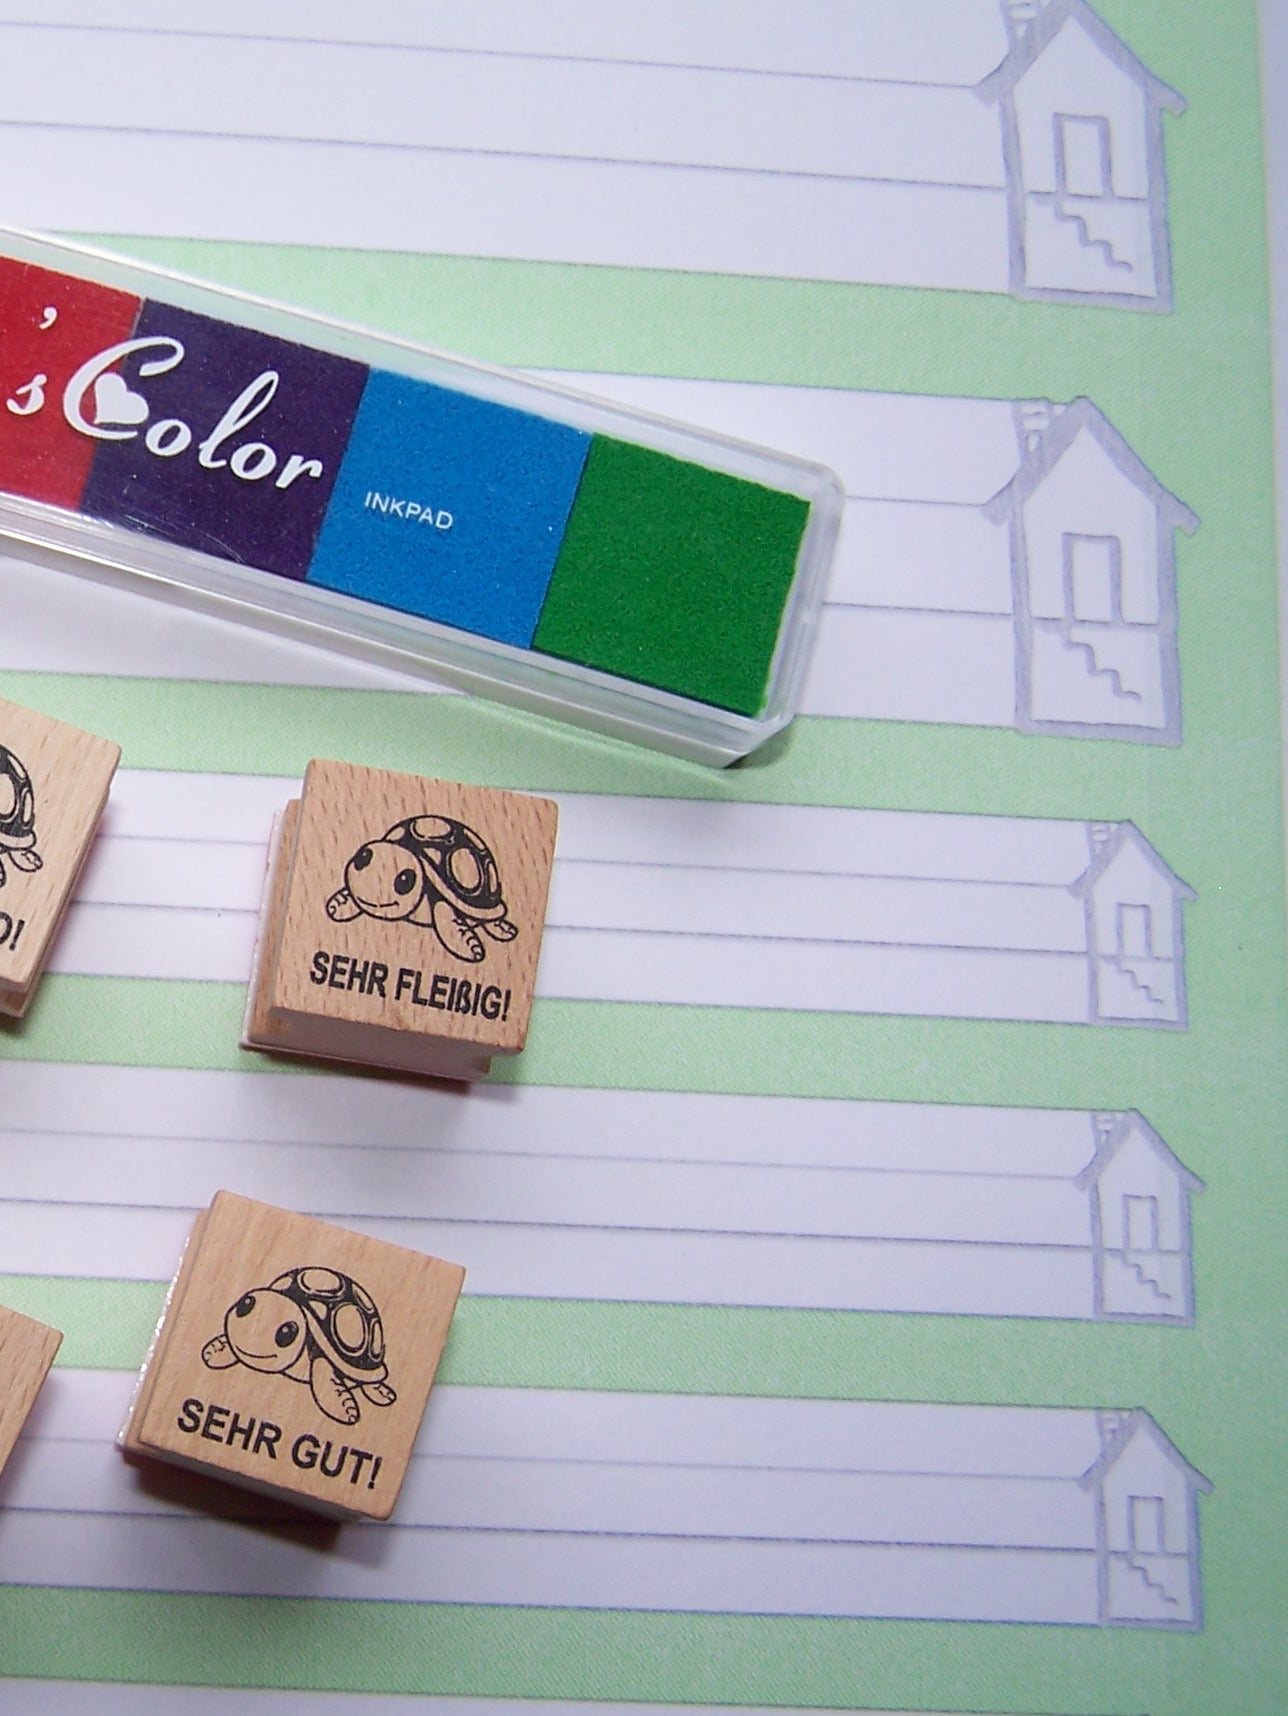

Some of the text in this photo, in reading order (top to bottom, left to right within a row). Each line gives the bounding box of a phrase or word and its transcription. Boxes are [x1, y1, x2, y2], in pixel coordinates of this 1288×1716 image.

[63, 336, 322, 490] Color
[365, 491, 454, 532] INKPAD
[310, 950, 512, 1022] SEHR FLEIßIG!
[177, 1398, 383, 1490] SEHR GUT!
